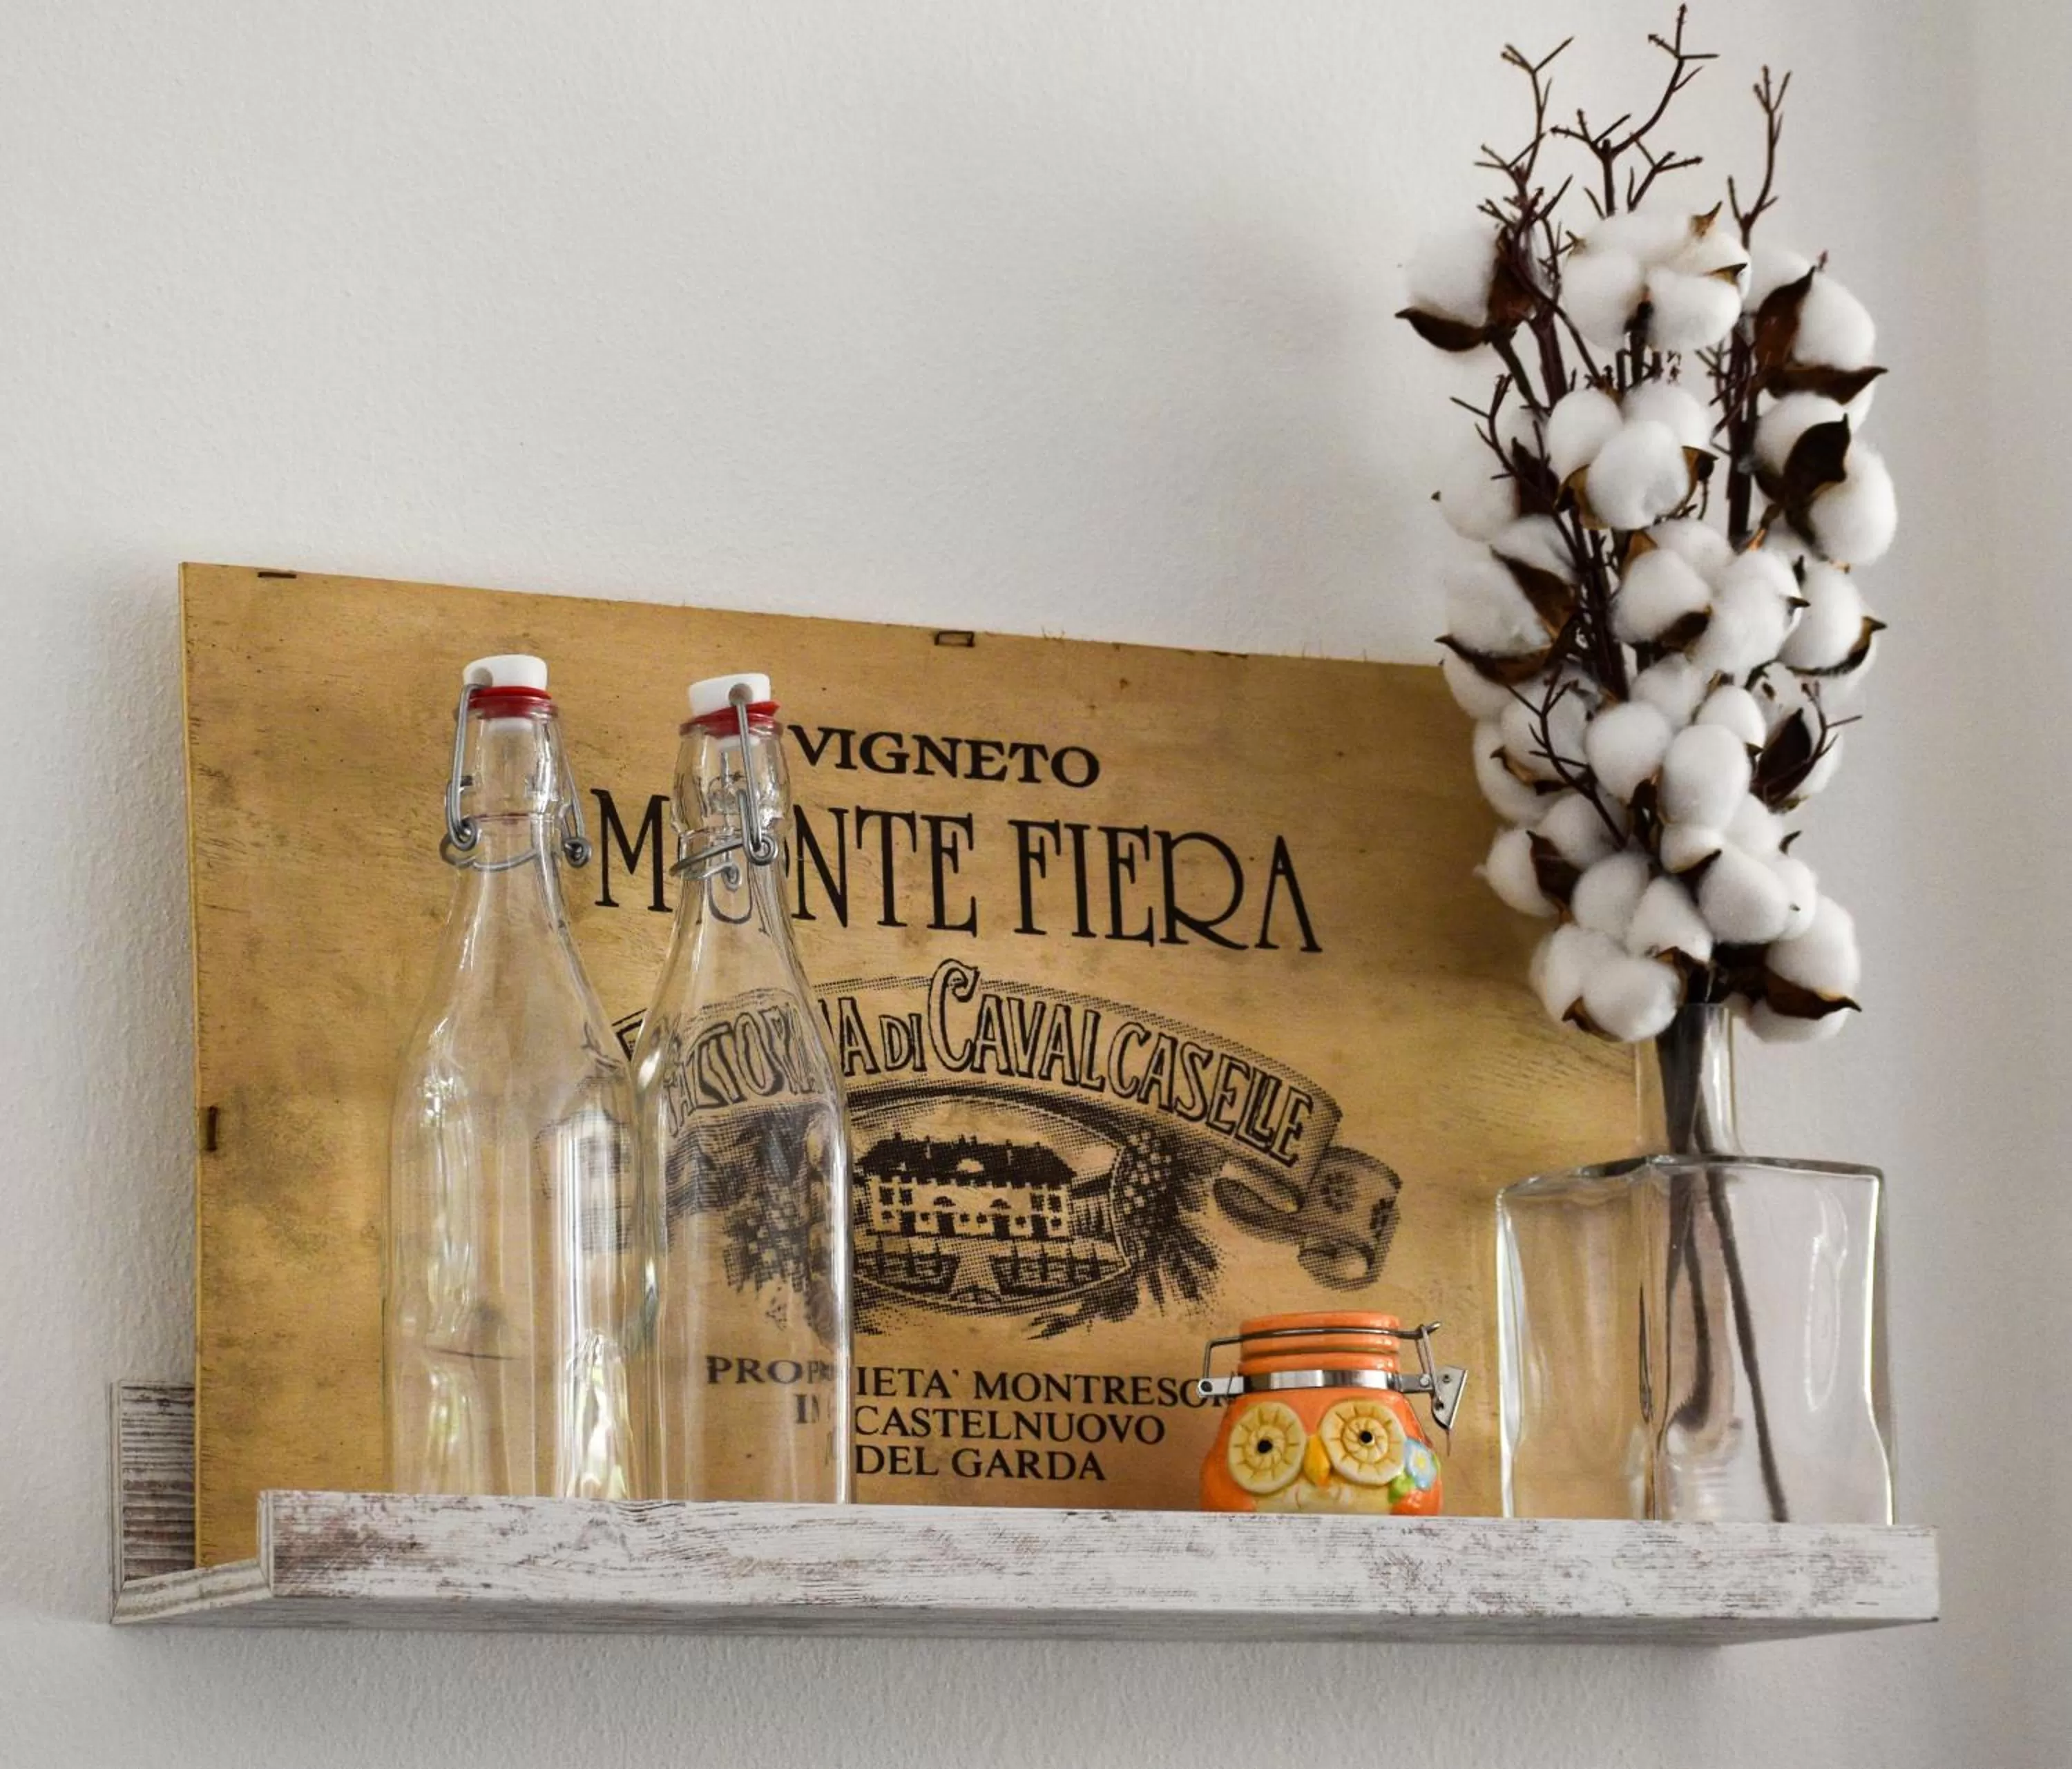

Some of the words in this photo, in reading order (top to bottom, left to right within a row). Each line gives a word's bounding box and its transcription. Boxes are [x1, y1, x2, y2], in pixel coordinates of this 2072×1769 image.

[787, 724, 1100, 788] VIGNETO
[1007, 818, 1322, 952] FIERA
[879, 1013, 927, 1072] DI
[928, 958, 1314, 1167] CAVALCASELLE
[855, 1405, 1165, 1445] CASTELNUOVO
[856, 1444, 939, 1476] DEL
[952, 1448, 1107, 1481] GARDA
